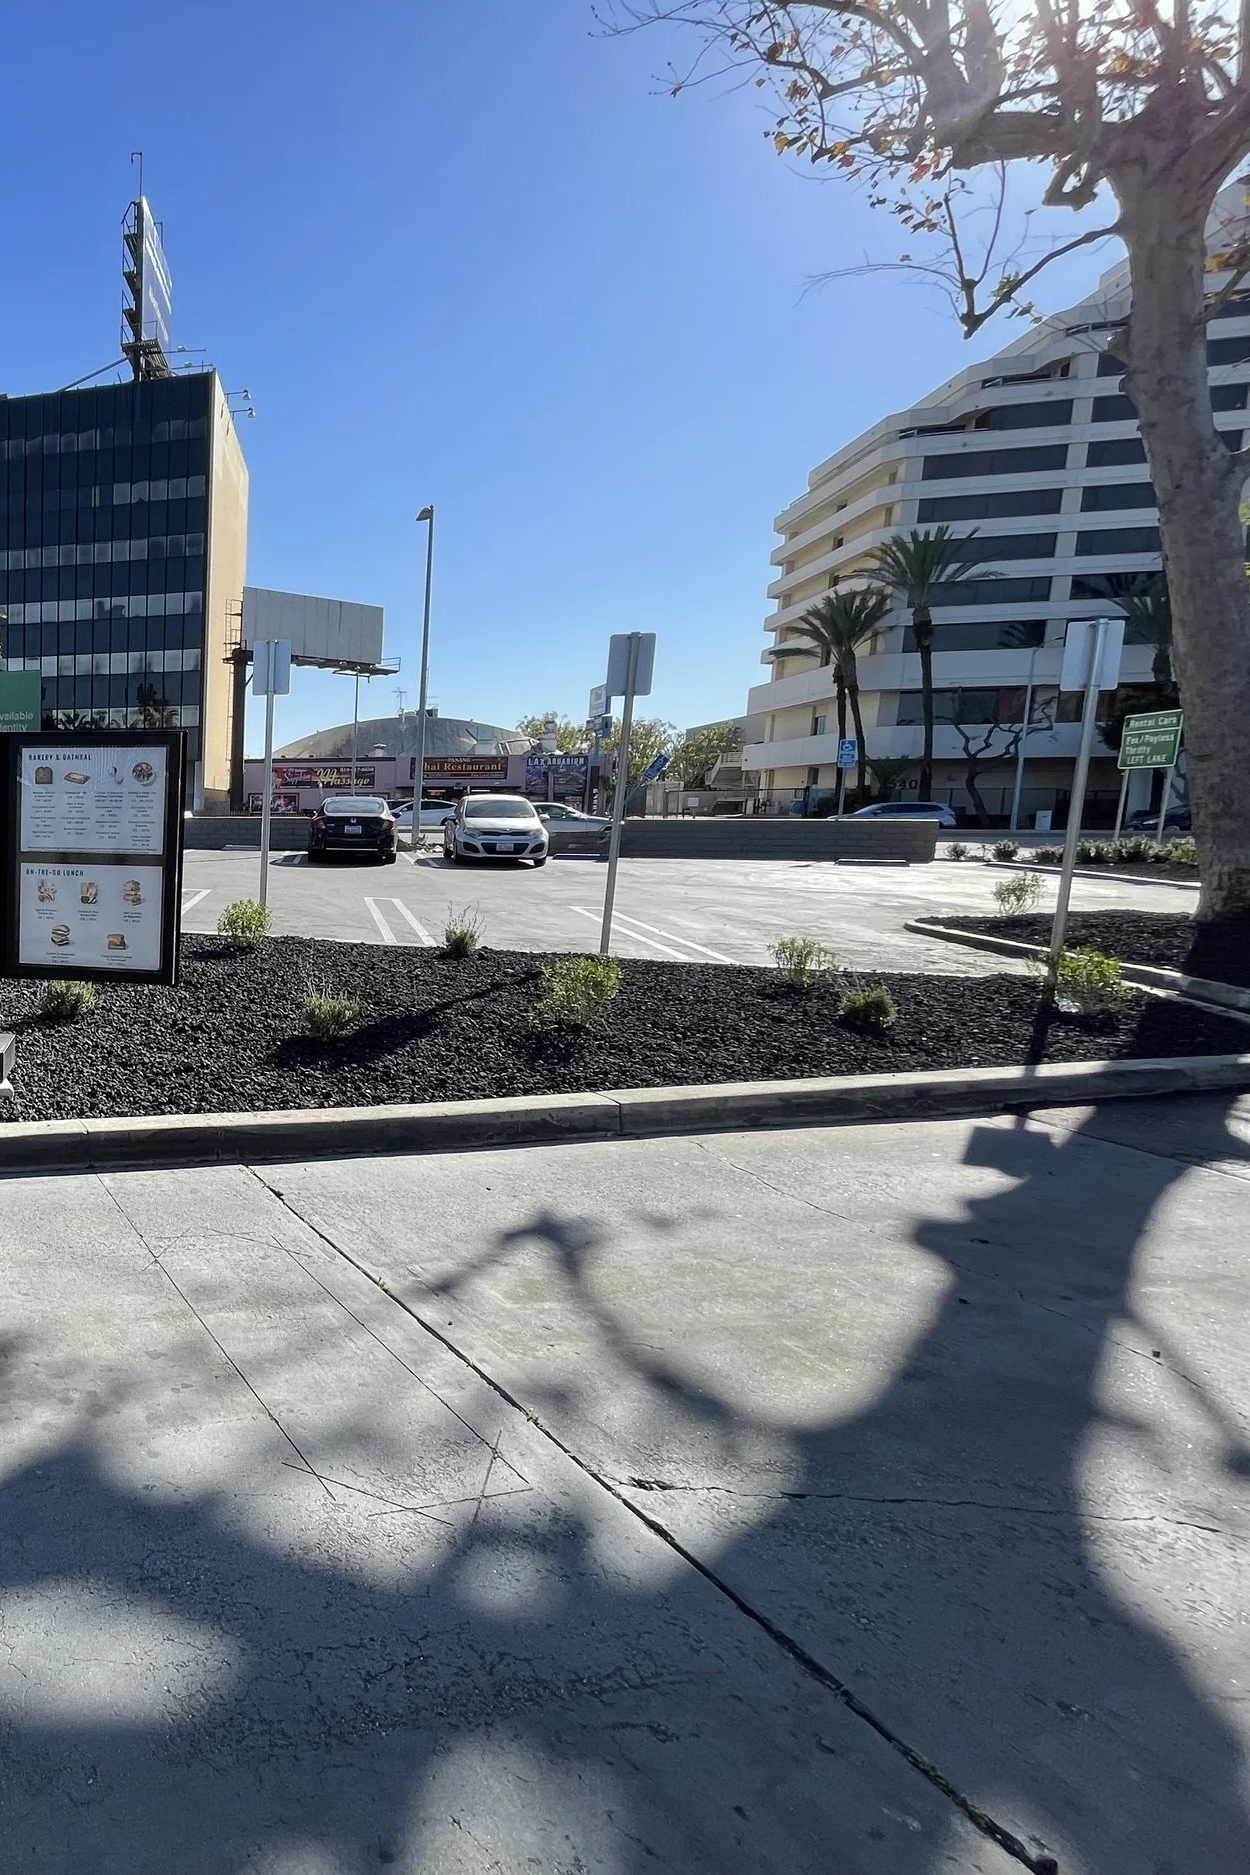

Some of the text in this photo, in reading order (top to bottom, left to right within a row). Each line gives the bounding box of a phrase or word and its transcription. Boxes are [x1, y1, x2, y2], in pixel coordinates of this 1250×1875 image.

[1129, 716, 1177, 728] Rental Cars
[528, 757, 545, 766] LAX
[423, 762, 502, 771] hai Restaurant
[63, 869, 84, 877] LUNCH
